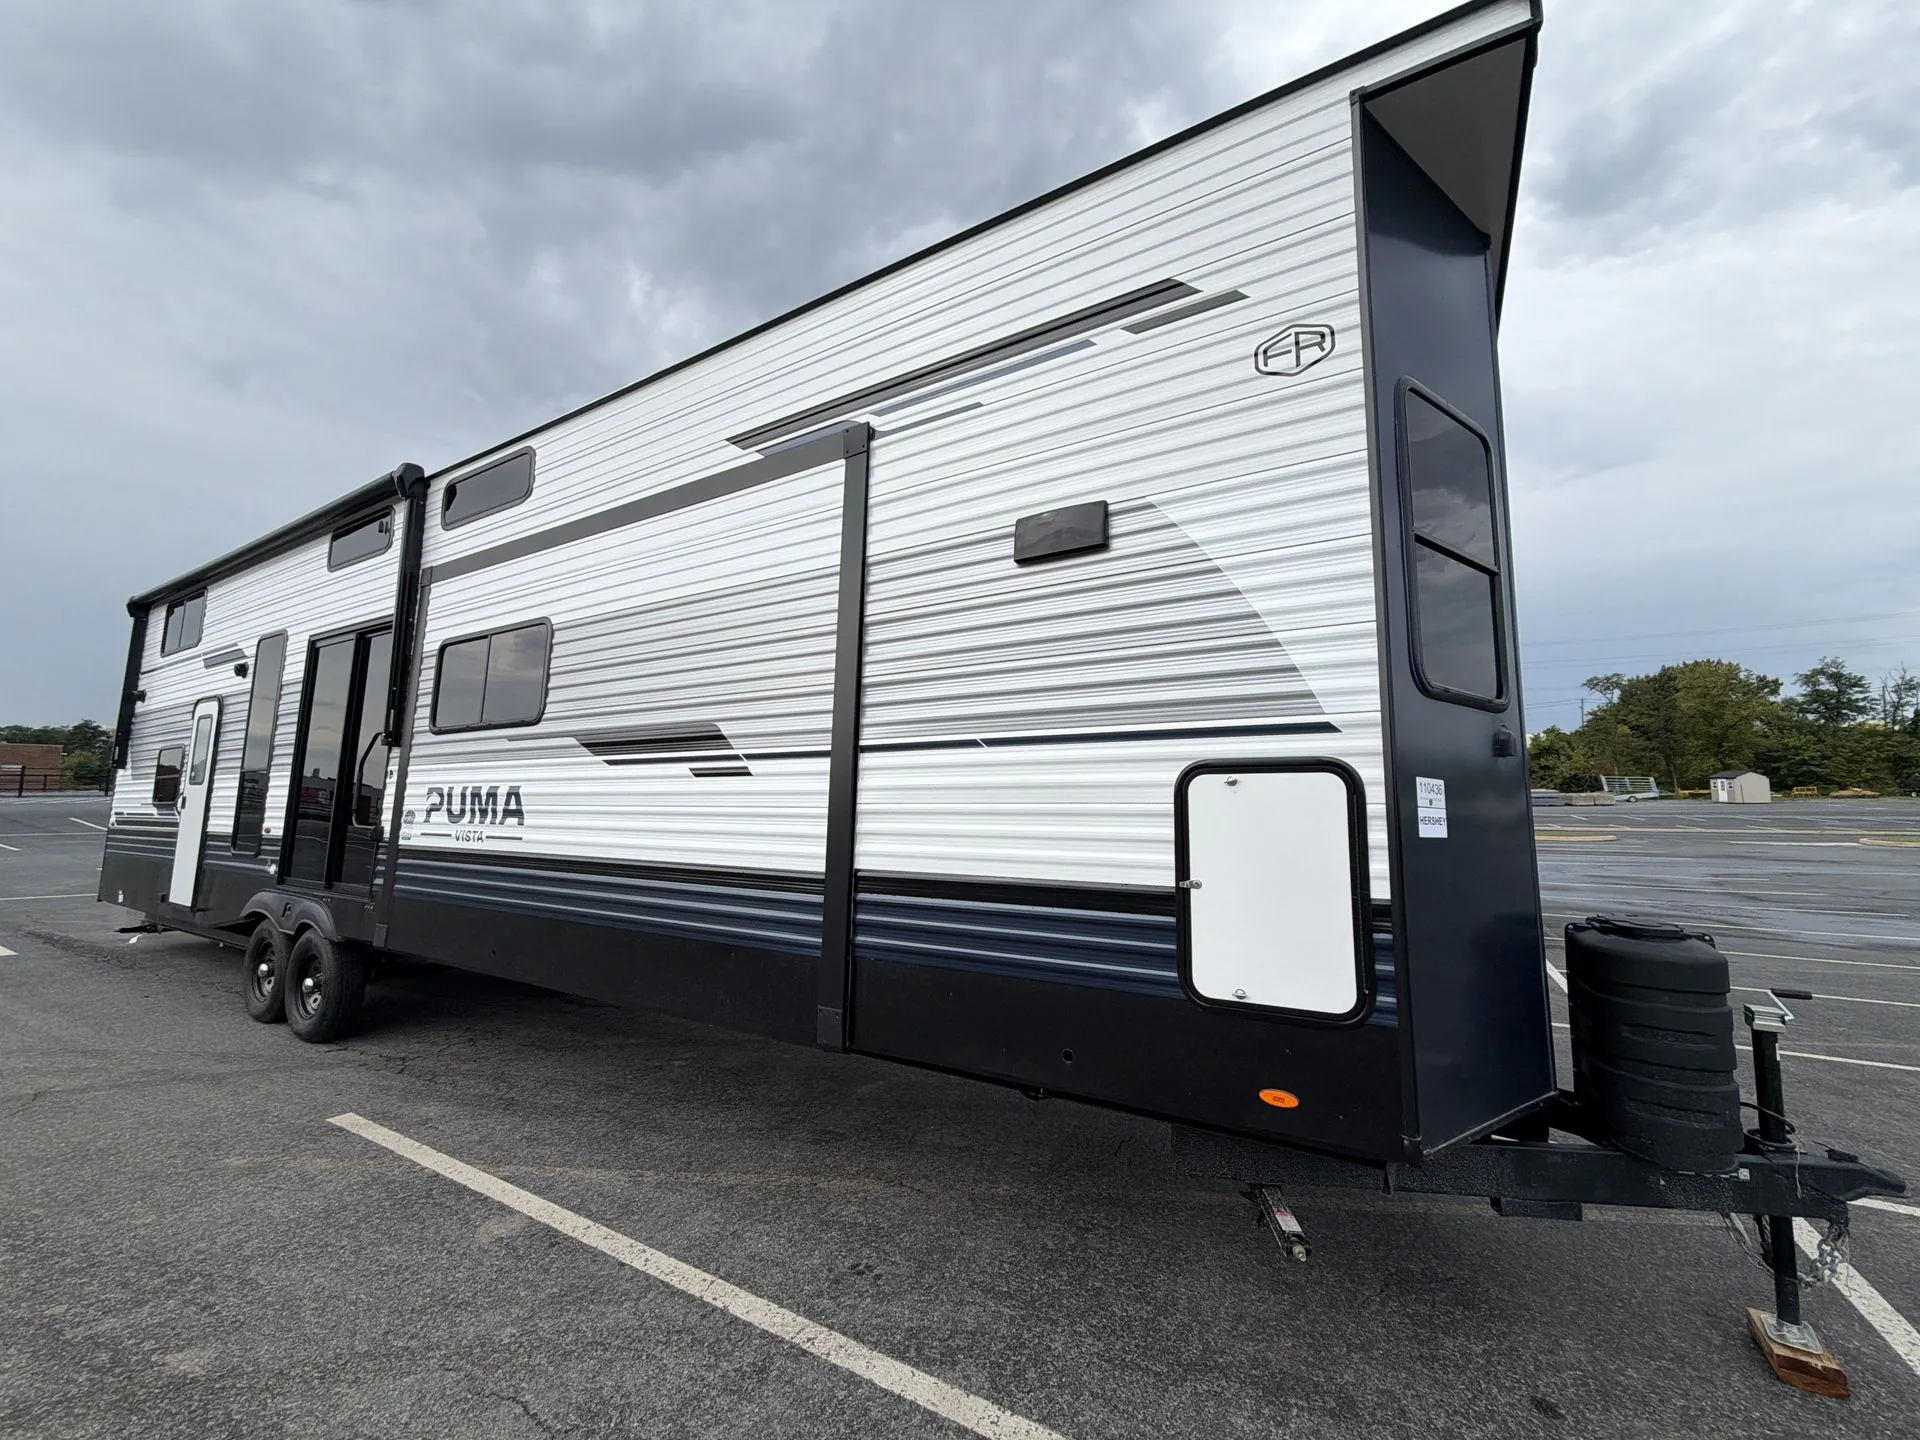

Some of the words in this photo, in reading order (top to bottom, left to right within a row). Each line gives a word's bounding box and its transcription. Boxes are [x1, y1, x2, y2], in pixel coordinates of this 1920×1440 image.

[1419, 782, 1443, 796] 110436
[423, 785, 525, 826] PUMA
[1419, 816, 1446, 826] HERSHEY
[455, 829, 484, 843] VISTA
